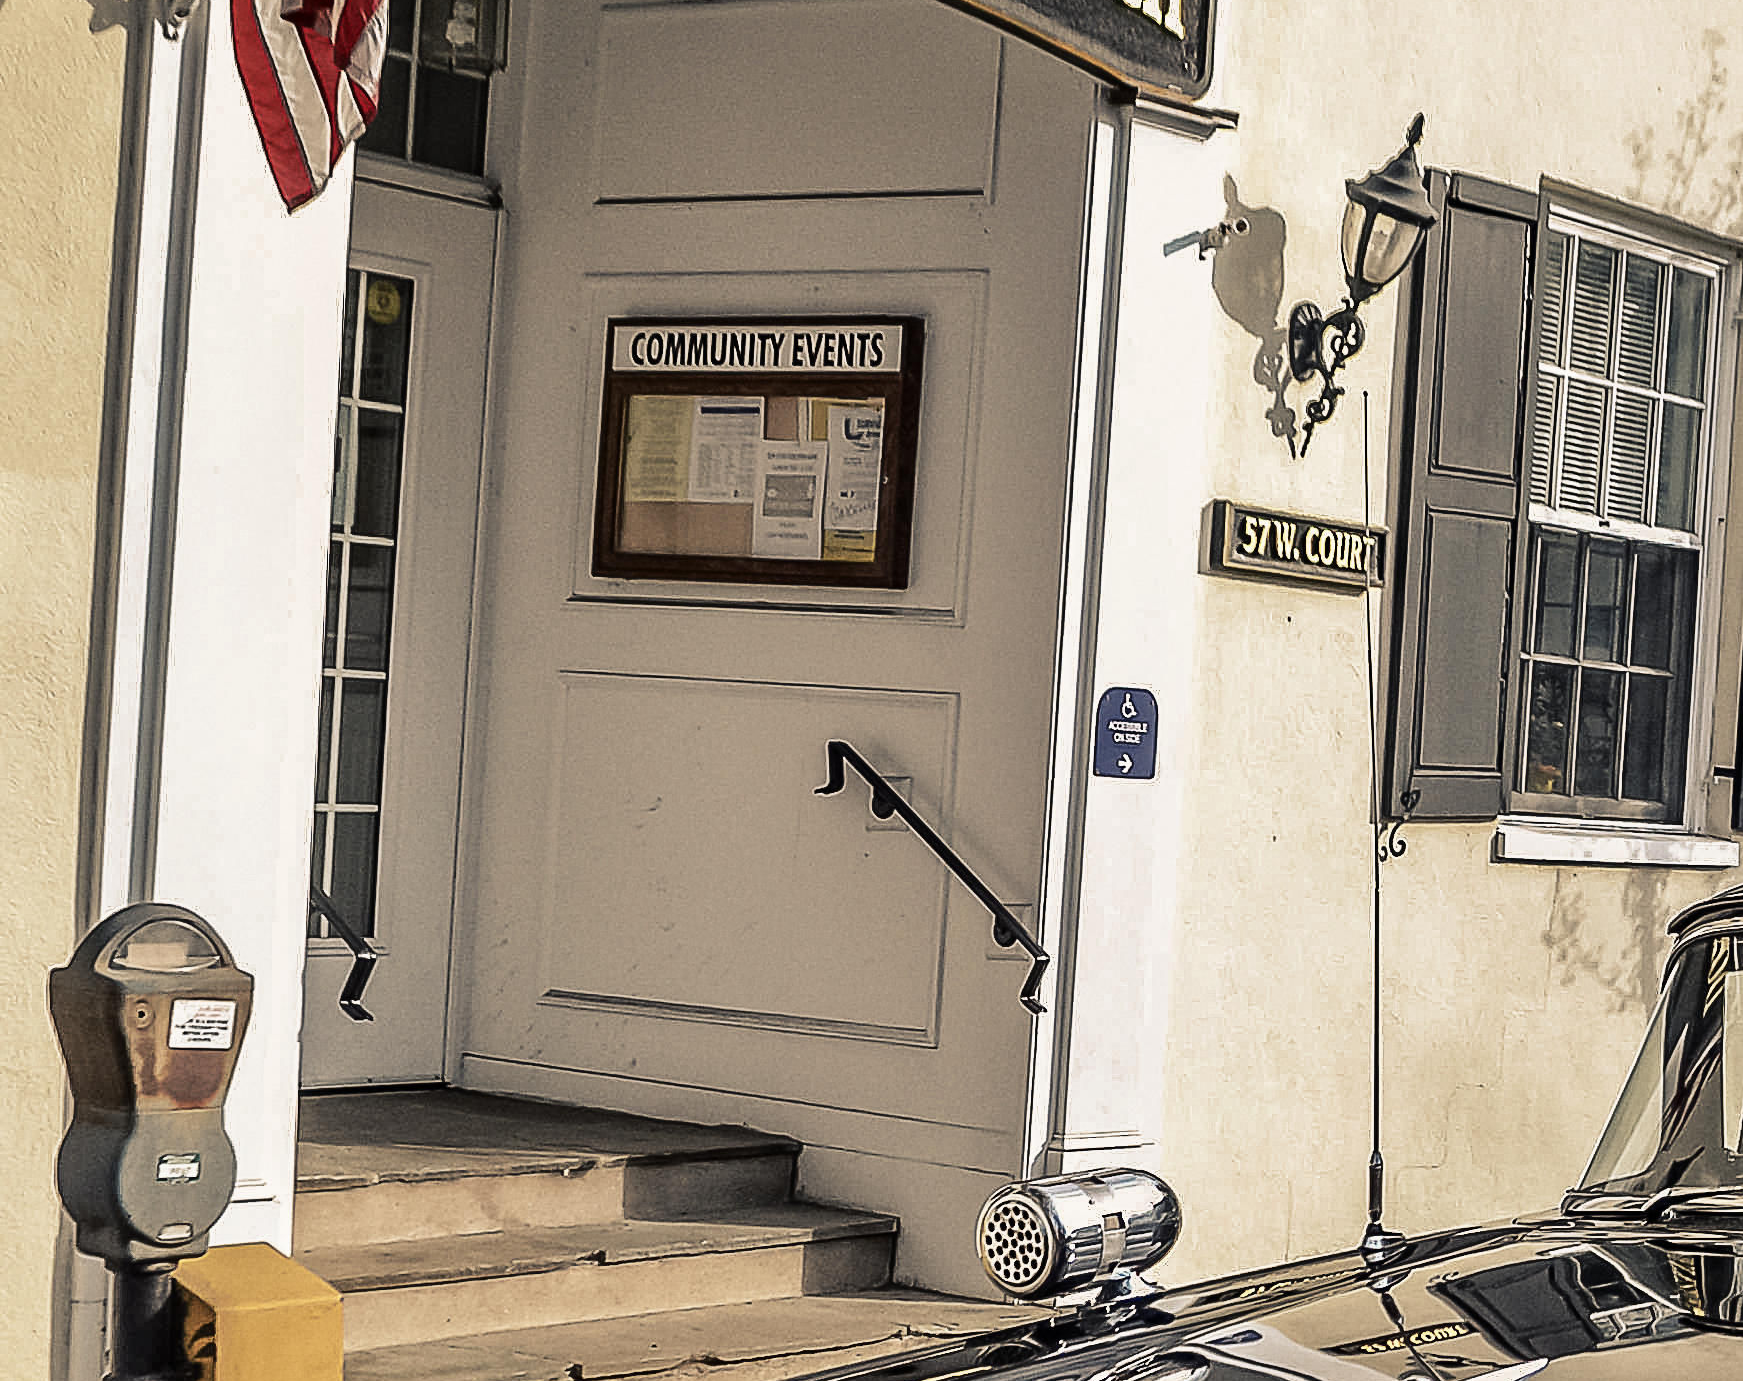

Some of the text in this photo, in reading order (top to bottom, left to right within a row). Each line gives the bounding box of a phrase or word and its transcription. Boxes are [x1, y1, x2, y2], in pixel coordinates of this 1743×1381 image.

[630, 331, 885, 368] COMMUNITY EVENTS
[1242, 516, 1376, 571] 57 W. COURT
